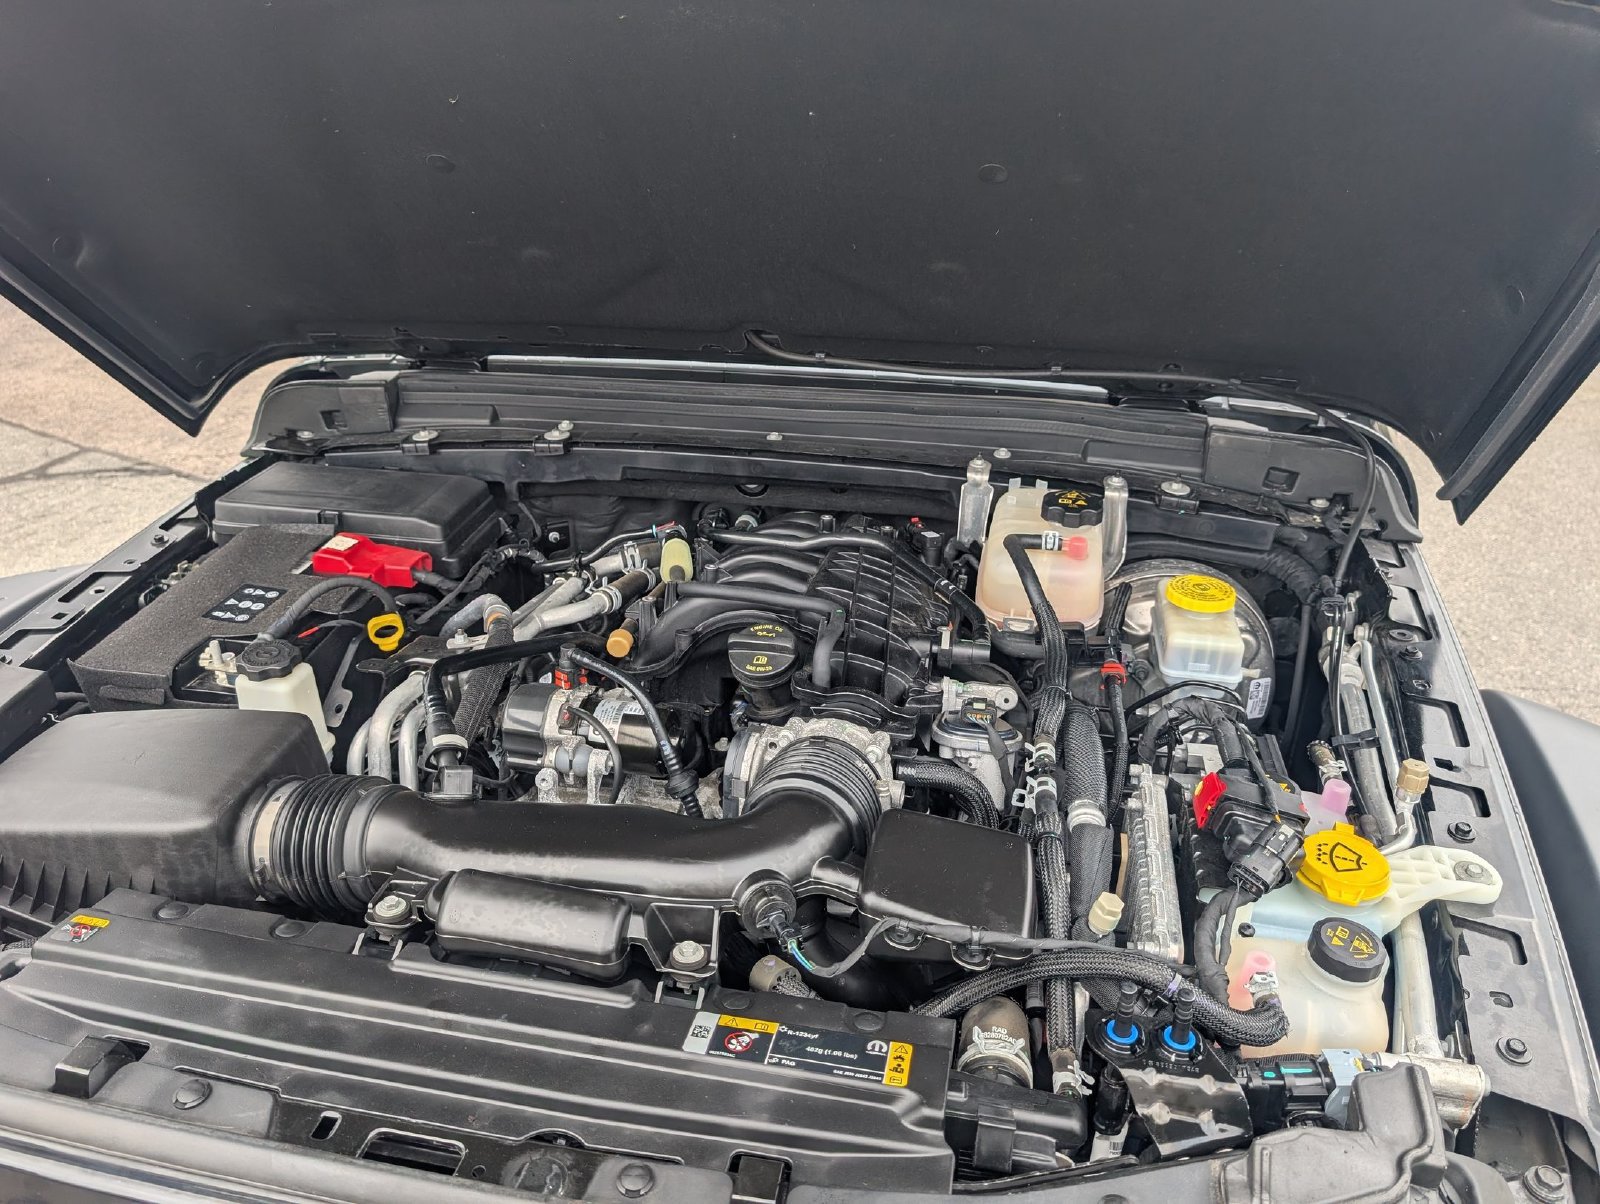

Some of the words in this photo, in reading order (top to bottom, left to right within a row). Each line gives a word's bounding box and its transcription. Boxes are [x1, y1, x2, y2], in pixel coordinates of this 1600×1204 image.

[787, 1029, 819, 1039] R-1234yf
[992, 1026, 1008, 1034] RAD
[844, 1051, 858, 1060] lbs)
[781, 1059, 796, 1067] PAG
